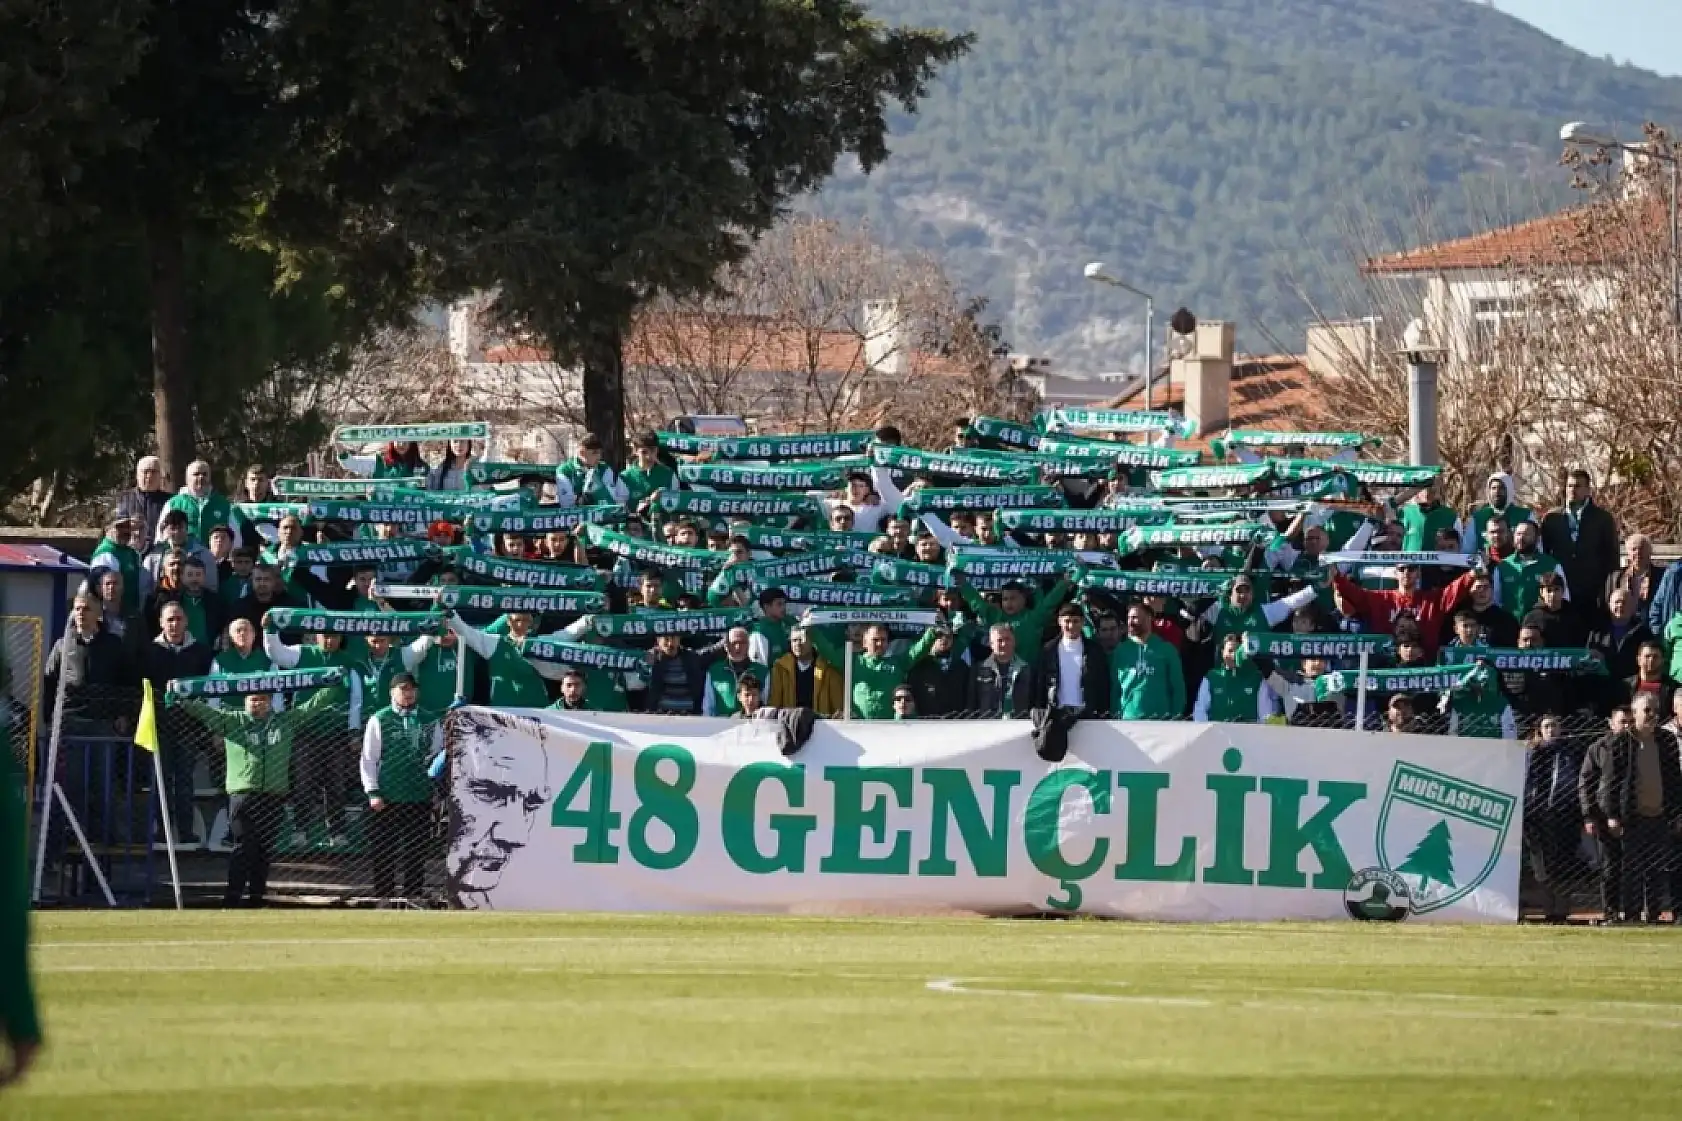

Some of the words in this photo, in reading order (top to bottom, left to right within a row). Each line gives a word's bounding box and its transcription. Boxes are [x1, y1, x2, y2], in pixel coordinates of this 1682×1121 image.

[749, 443, 771, 457] 48
[779, 438, 852, 458] GENÇLİK
[899, 454, 921, 469] 48
[928, 459, 1000, 479] GENÇLİK
[710, 470, 734, 483] 48
[740, 467, 814, 489] GENÇLİK
[687, 499, 712, 513] 48
[718, 496, 792, 516] GENÇLİK
[932, 494, 959, 508] 48
[963, 491, 1036, 510] GENÇLİK
[338, 507, 362, 520] 48
[369, 506, 444, 524] GENÇLİK
[501, 517, 525, 531] 48
[1030, 515, 1055, 529] 48
[1061, 511, 1138, 531] GENÇLİK
[307, 549, 334, 563] 48
[339, 544, 417, 563] GENÇLİK
[465, 556, 487, 574] 48
[493, 565, 568, 588] GENÇLİK
[765, 554, 837, 579] GENÇLİK
[963, 561, 986, 575] 48
[991, 559, 1056, 578] GENÇLİK
[906, 570, 931, 586] 48
[1103, 577, 1127, 590] 48
[1135, 577, 1211, 597] GENÇLİK
[468, 594, 493, 609] 48
[501, 592, 578, 613] GENÇLİK
[808, 587, 884, 606] GENÇLİK
[300, 616, 326, 631] 48
[332, 614, 411, 635] GENÇLİK
[622, 621, 647, 635] 48
[653, 614, 727, 635] GENÇLİK
[830, 612, 848, 620] 48
[530, 643, 552, 657] 48
[560, 648, 638, 670] GENÇLİK
[1269, 641, 1294, 656] 48
[1300, 639, 1376, 659] GENÇLİK
[1495, 651, 1572, 672] GENÇLİK
[203, 680, 230, 694] 48
[236, 673, 315, 694] GENÇLİK
[551, 741, 700, 870] 48
[721, 747, 1367, 911] GENÇLİK
